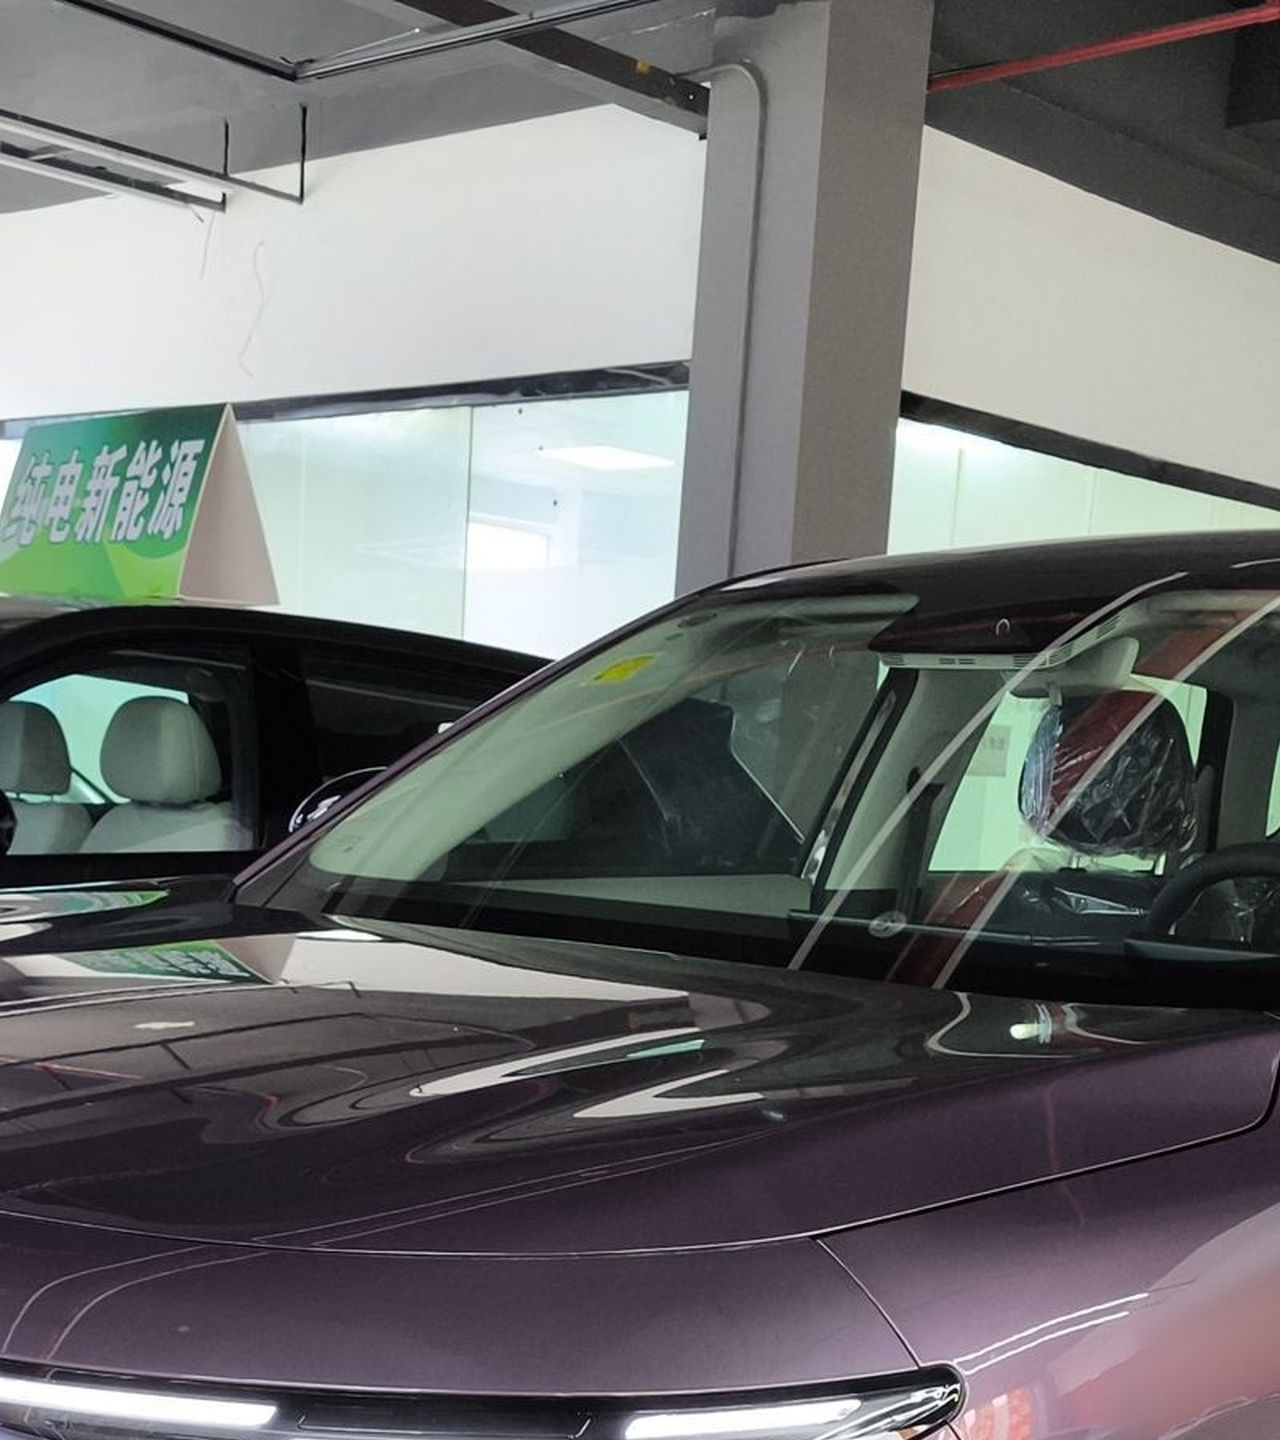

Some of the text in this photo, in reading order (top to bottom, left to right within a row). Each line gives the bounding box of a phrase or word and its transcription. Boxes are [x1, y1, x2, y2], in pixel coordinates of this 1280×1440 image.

[6, 439, 205, 544] 纯电新能源
